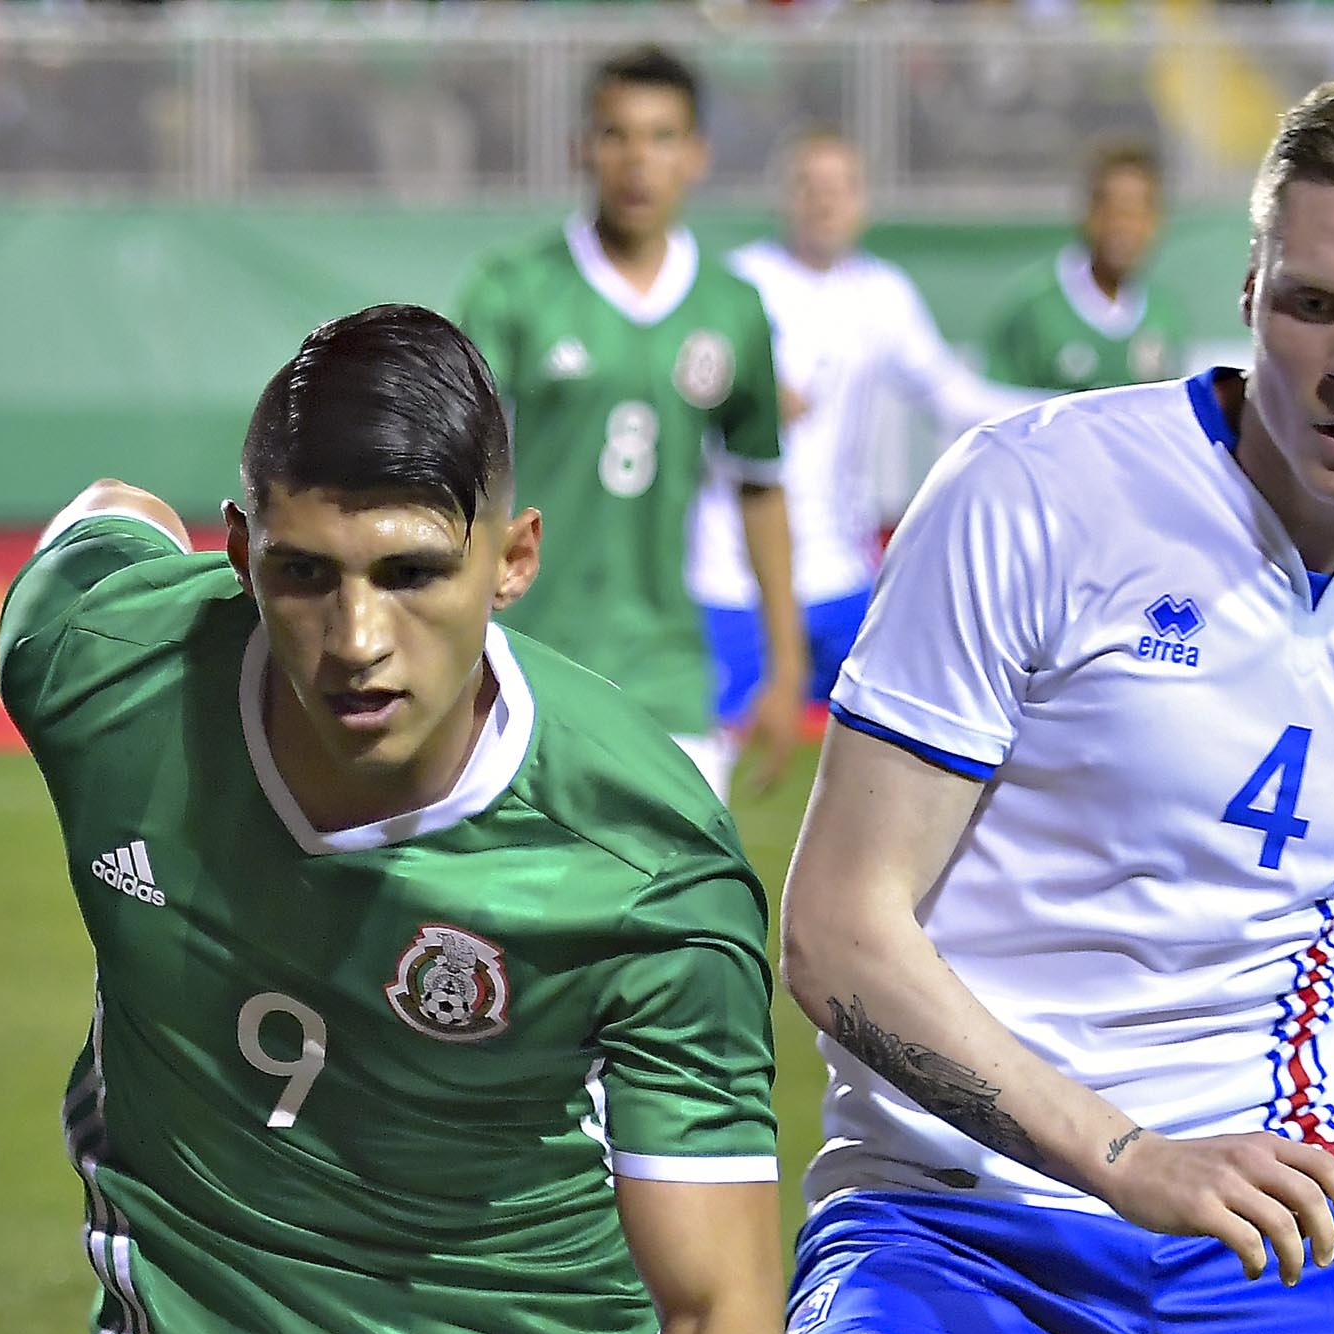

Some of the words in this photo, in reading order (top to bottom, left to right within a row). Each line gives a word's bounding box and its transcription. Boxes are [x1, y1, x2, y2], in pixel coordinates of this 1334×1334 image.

[598, 400, 659, 498] 8
[1220, 724, 1314, 871] 4
[91, 860, 166, 907] adidas
[237, 992, 328, 1128] 9
